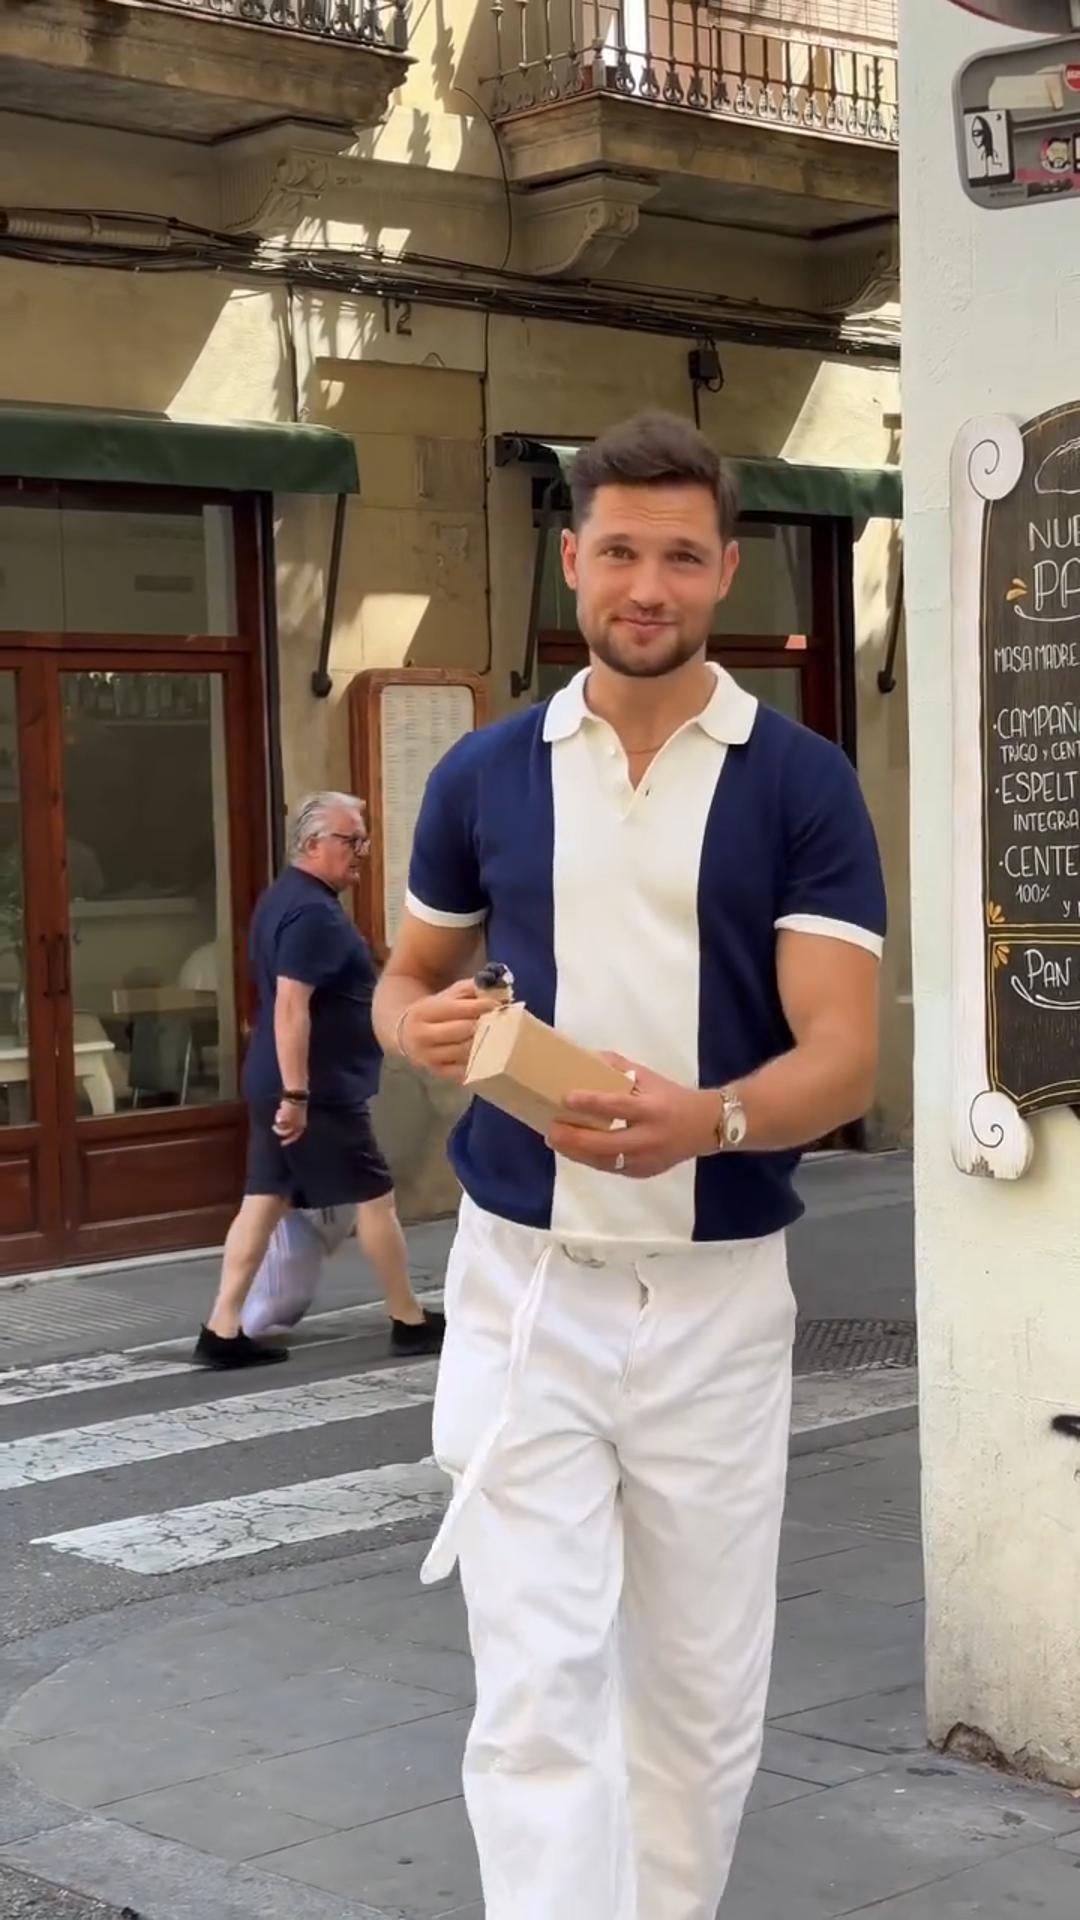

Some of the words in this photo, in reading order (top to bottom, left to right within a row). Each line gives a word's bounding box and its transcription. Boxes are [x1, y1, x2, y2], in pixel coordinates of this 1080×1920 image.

[382, 298, 412, 336] 12
[994, 645, 1033, 673] MASA
[1035, 642, 1080, 671] MADRE
[997, 701, 1080, 739] CAMPAÑ
[1002, 770, 1079, 804] ESPELT
[1013, 808, 1080, 832] INTEGRA
[1004, 845, 1080, 878] CENTE
[1015, 883, 1051, 903] 100%
